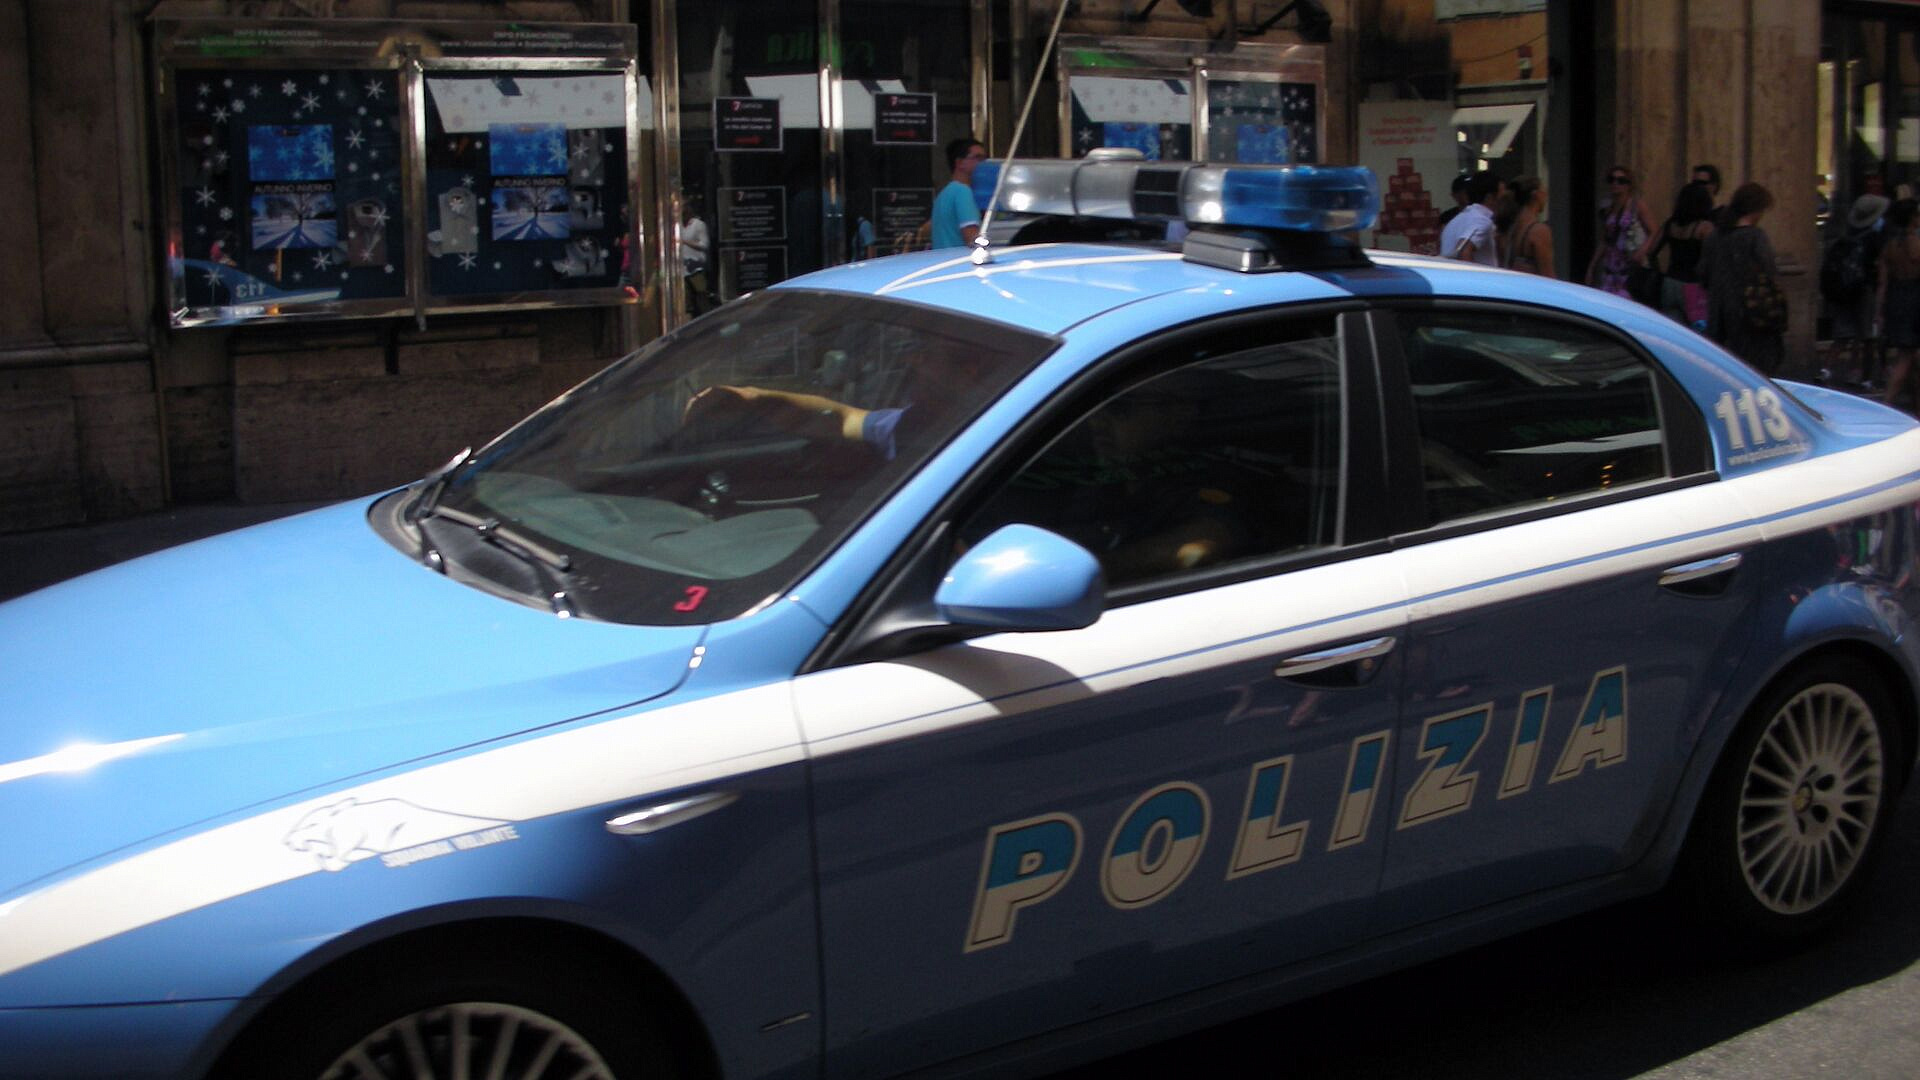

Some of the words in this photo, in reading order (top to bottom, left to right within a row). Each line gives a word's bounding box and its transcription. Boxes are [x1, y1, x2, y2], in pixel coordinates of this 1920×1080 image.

[1714, 386, 1791, 450] 113
[674, 585, 709, 613] 3
[963, 665, 1629, 953] POLIZIA
